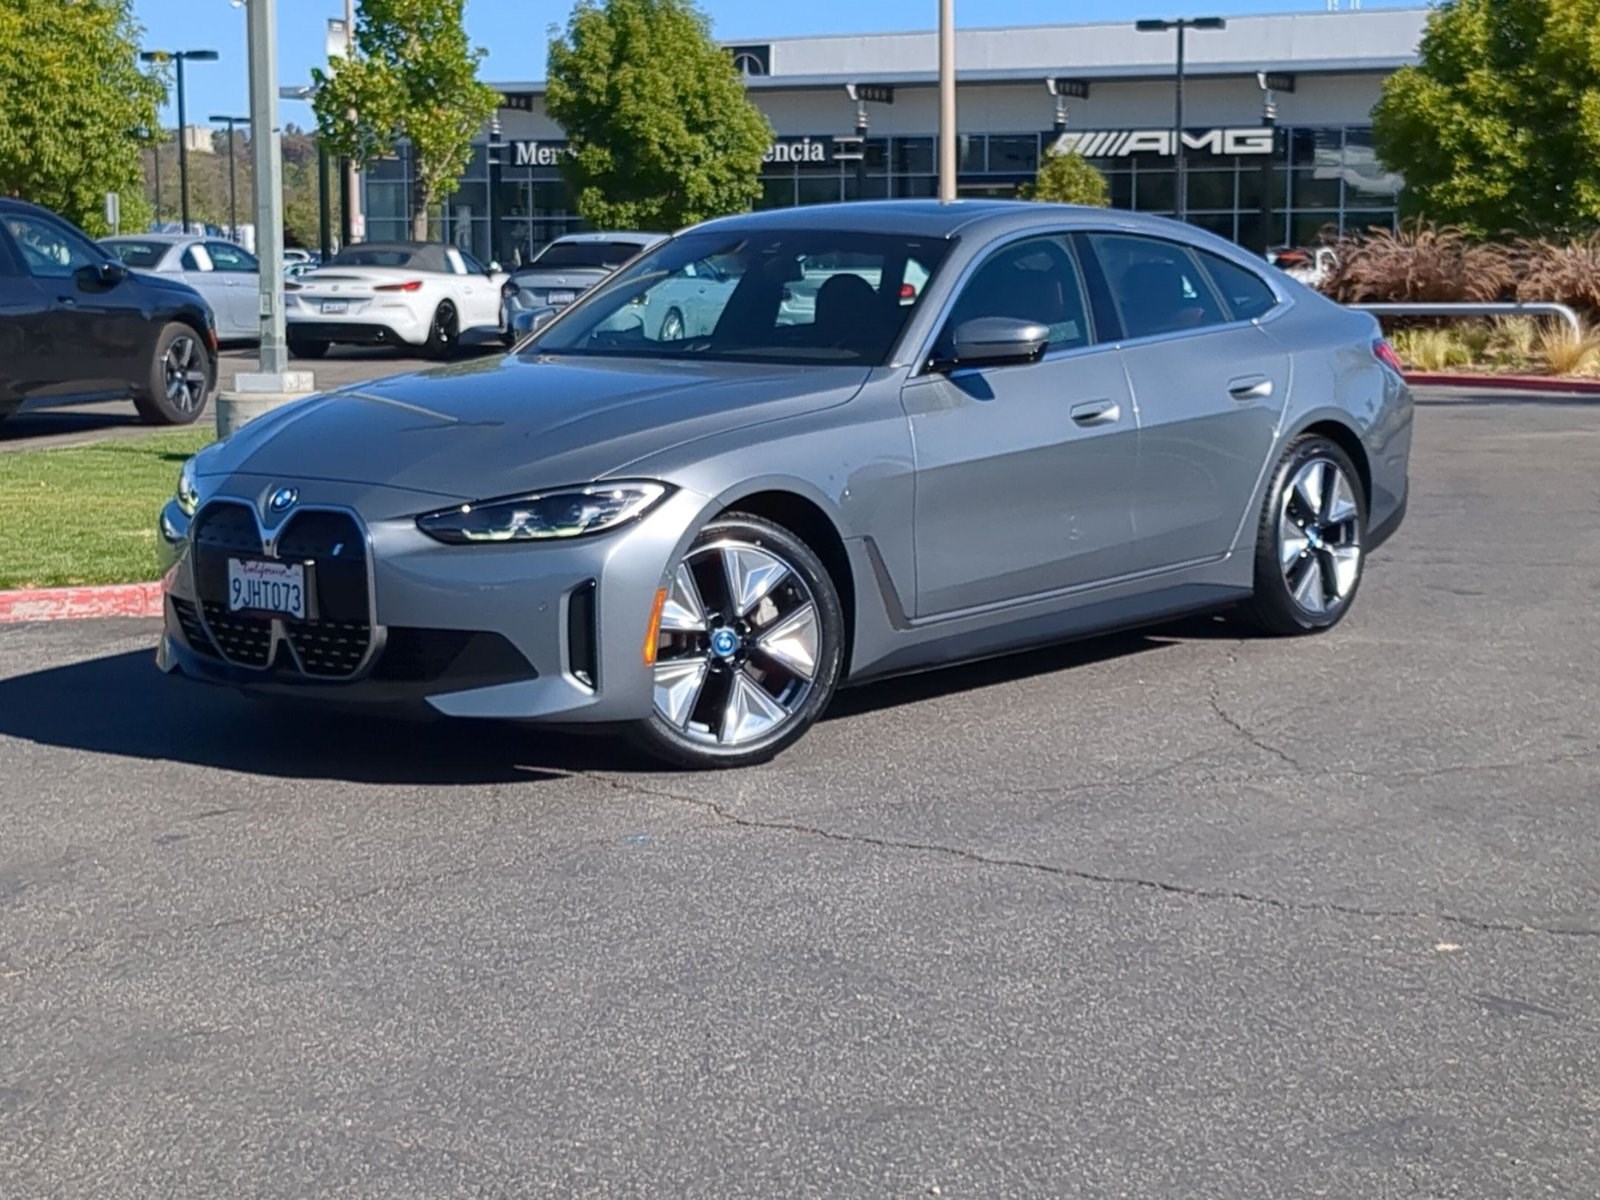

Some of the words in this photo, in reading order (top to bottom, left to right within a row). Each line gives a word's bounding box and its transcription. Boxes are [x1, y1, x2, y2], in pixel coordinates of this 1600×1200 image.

[515, 142, 566, 166] Mer
[763, 137, 826, 162] encia
[1117, 129, 1274, 156] AMG
[232, 577, 302, 612] 9JHT073
